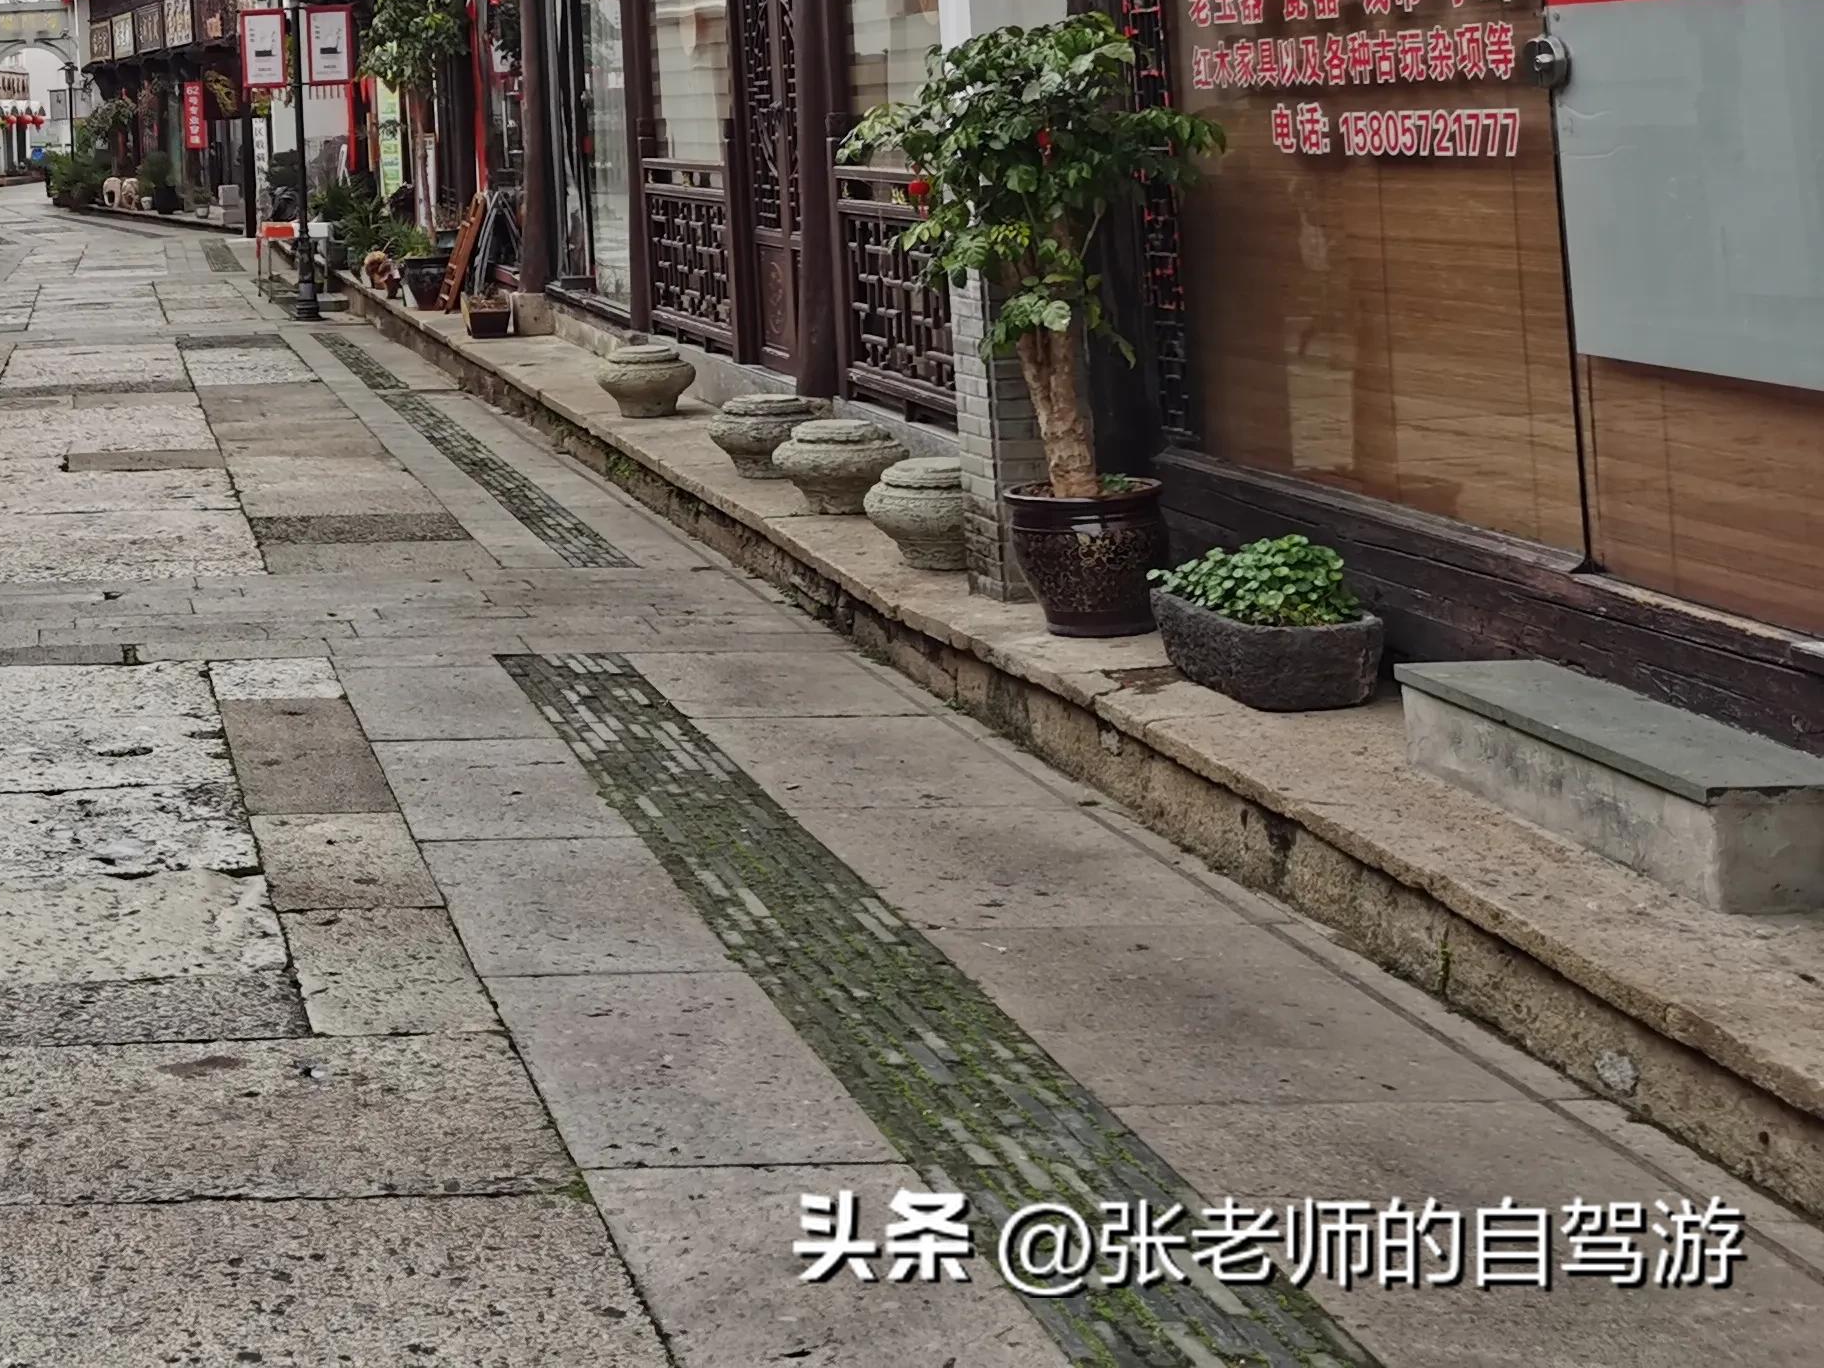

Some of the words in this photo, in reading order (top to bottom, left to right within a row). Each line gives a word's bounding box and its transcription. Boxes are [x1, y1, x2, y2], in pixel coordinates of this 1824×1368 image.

[1191, 20, 1516, 90] 红木家具以及各种古玩杂项等
[1339, 107, 1521, 157] 15805721777
